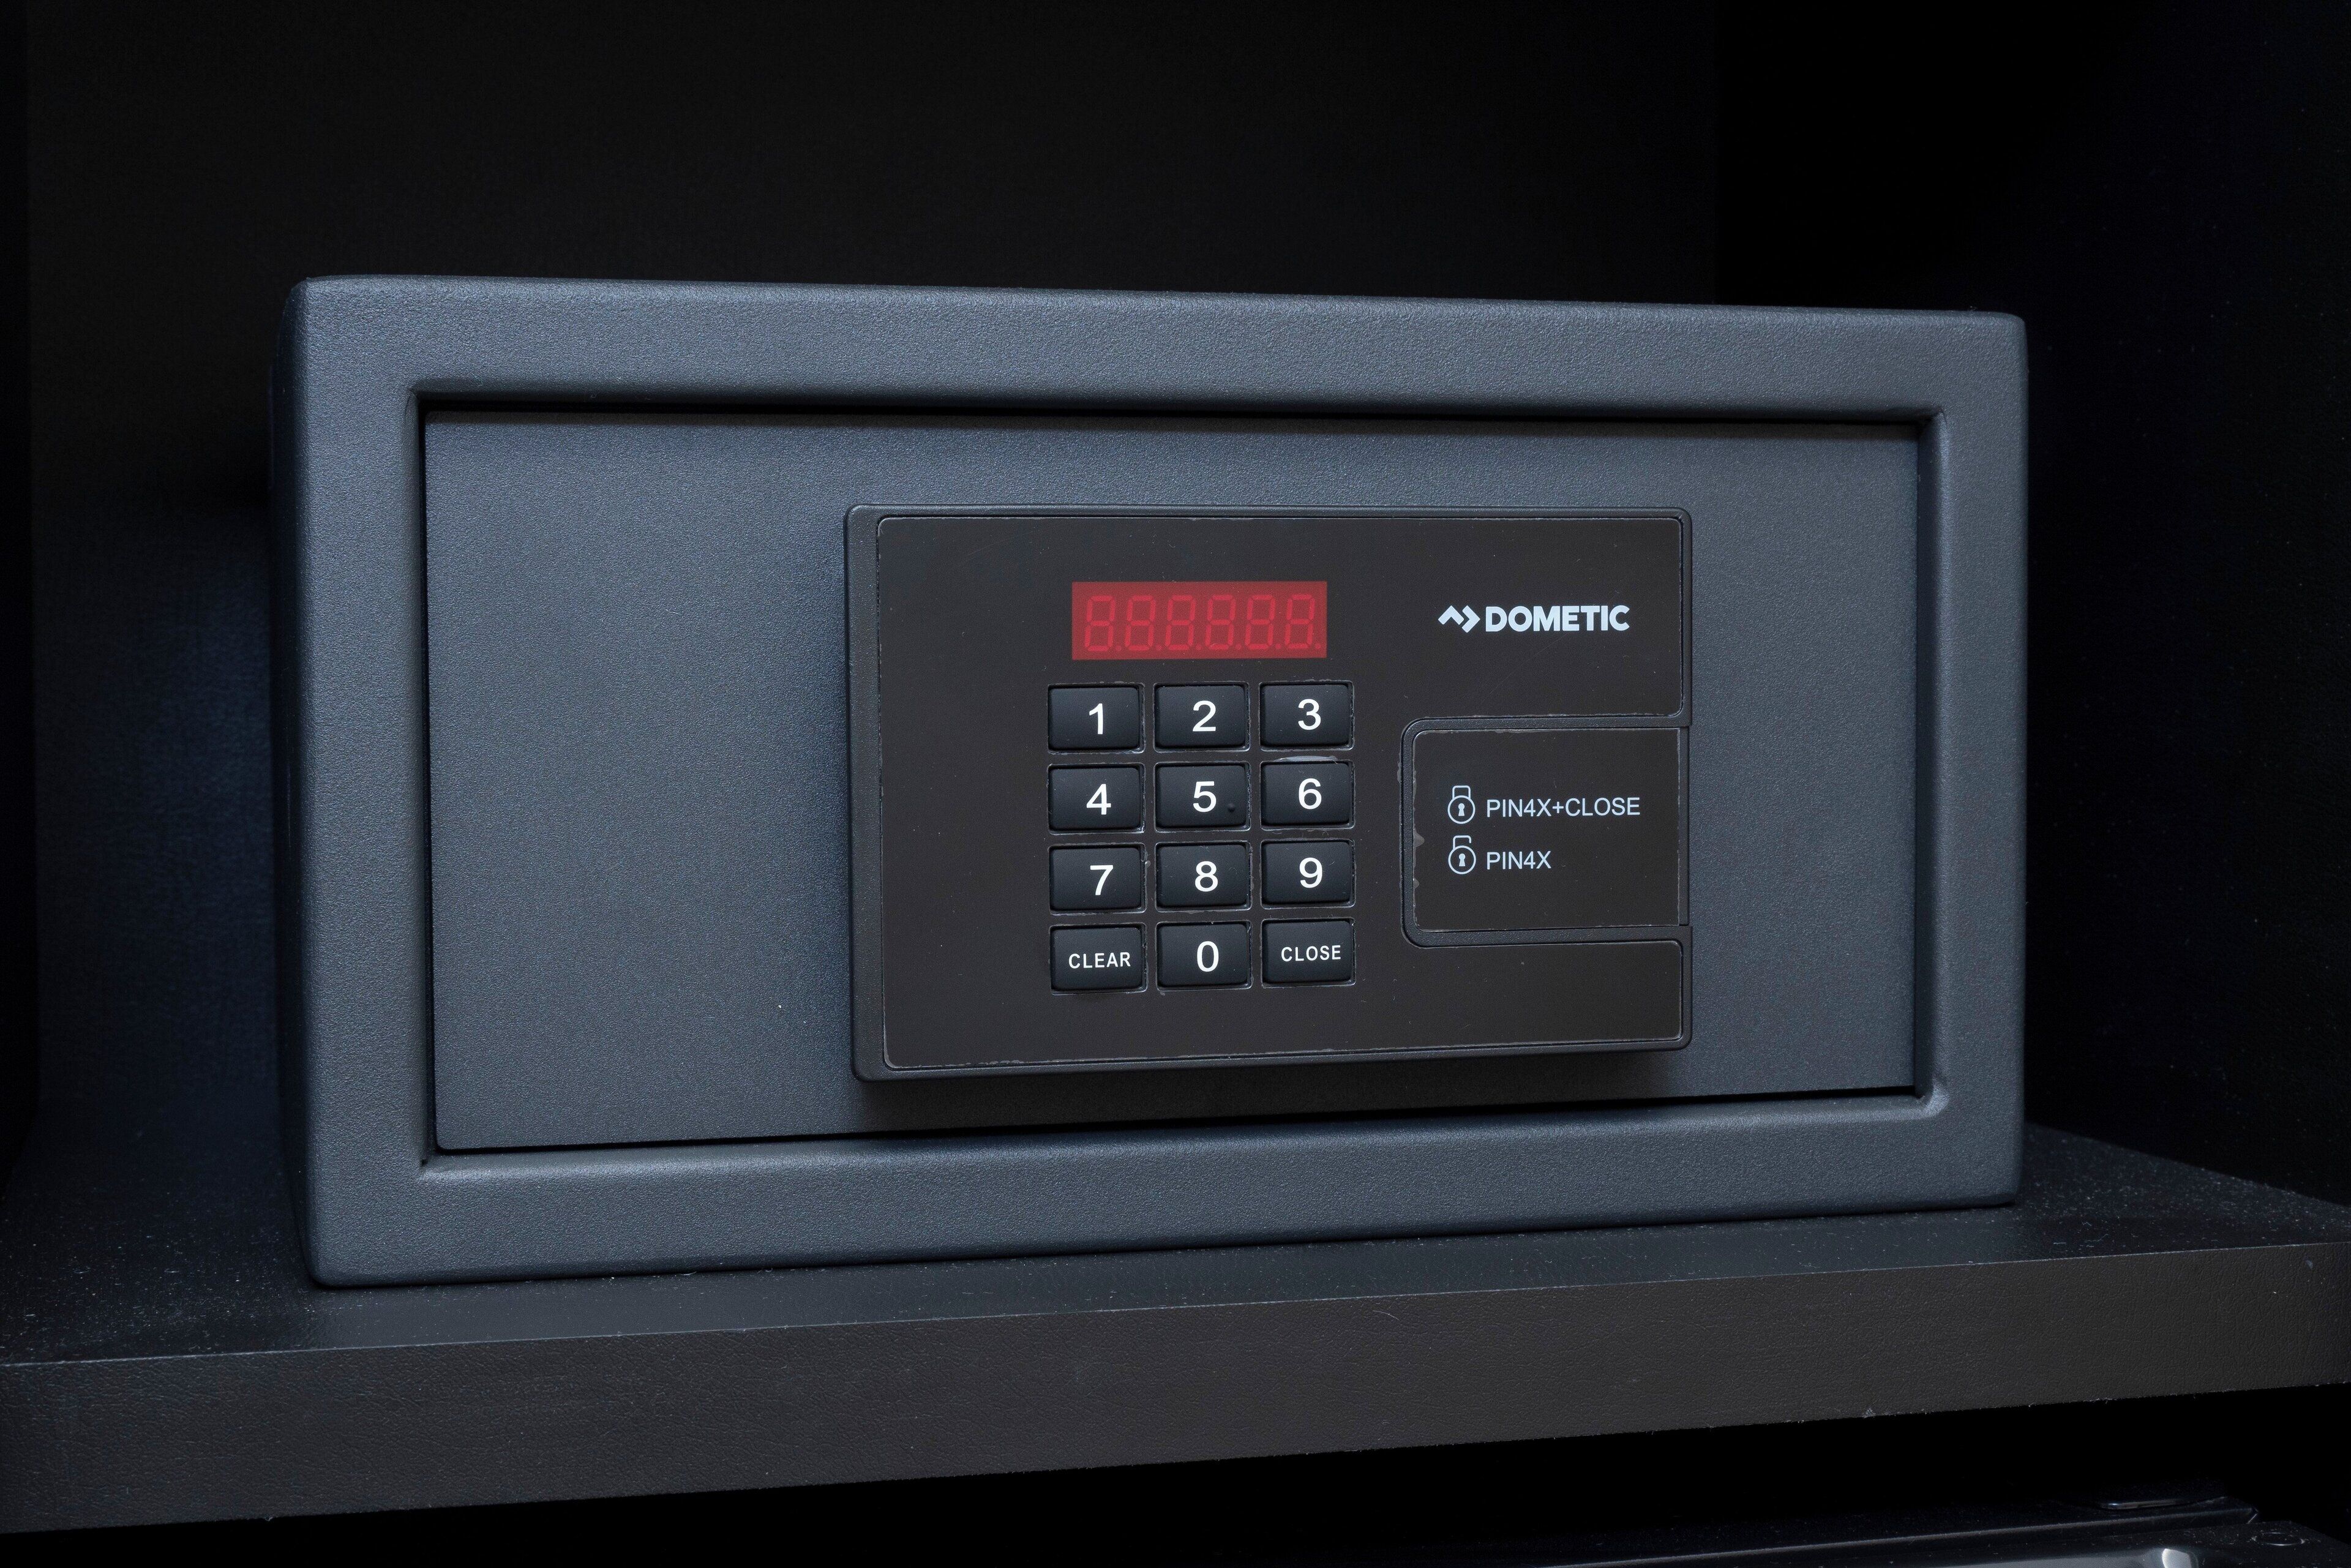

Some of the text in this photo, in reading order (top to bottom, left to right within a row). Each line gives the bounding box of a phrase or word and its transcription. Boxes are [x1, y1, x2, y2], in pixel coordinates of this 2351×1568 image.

[1485, 605, 1630, 632] DOMETIC
[1089, 703, 1104, 735] 1
[1193, 700, 1217, 732] 2
[1298, 699, 1321, 730] 3
[1086, 784, 1112, 816] 4
[1193, 781, 1217, 812] 5
[1298, 778, 1322, 810] 6
[1487, 797, 1640, 817] PIN4X+CLOSE
[1299, 857, 1323, 888] 9
[1487, 850, 1551, 870] PIN4X
[1090, 865, 1114, 896] 7
[1194, 860, 1218, 892] 8
[1068, 951, 1131, 969] CLEAR
[1197, 940, 1219, 972] 0
[1281, 945, 1341, 962] CLOSE
